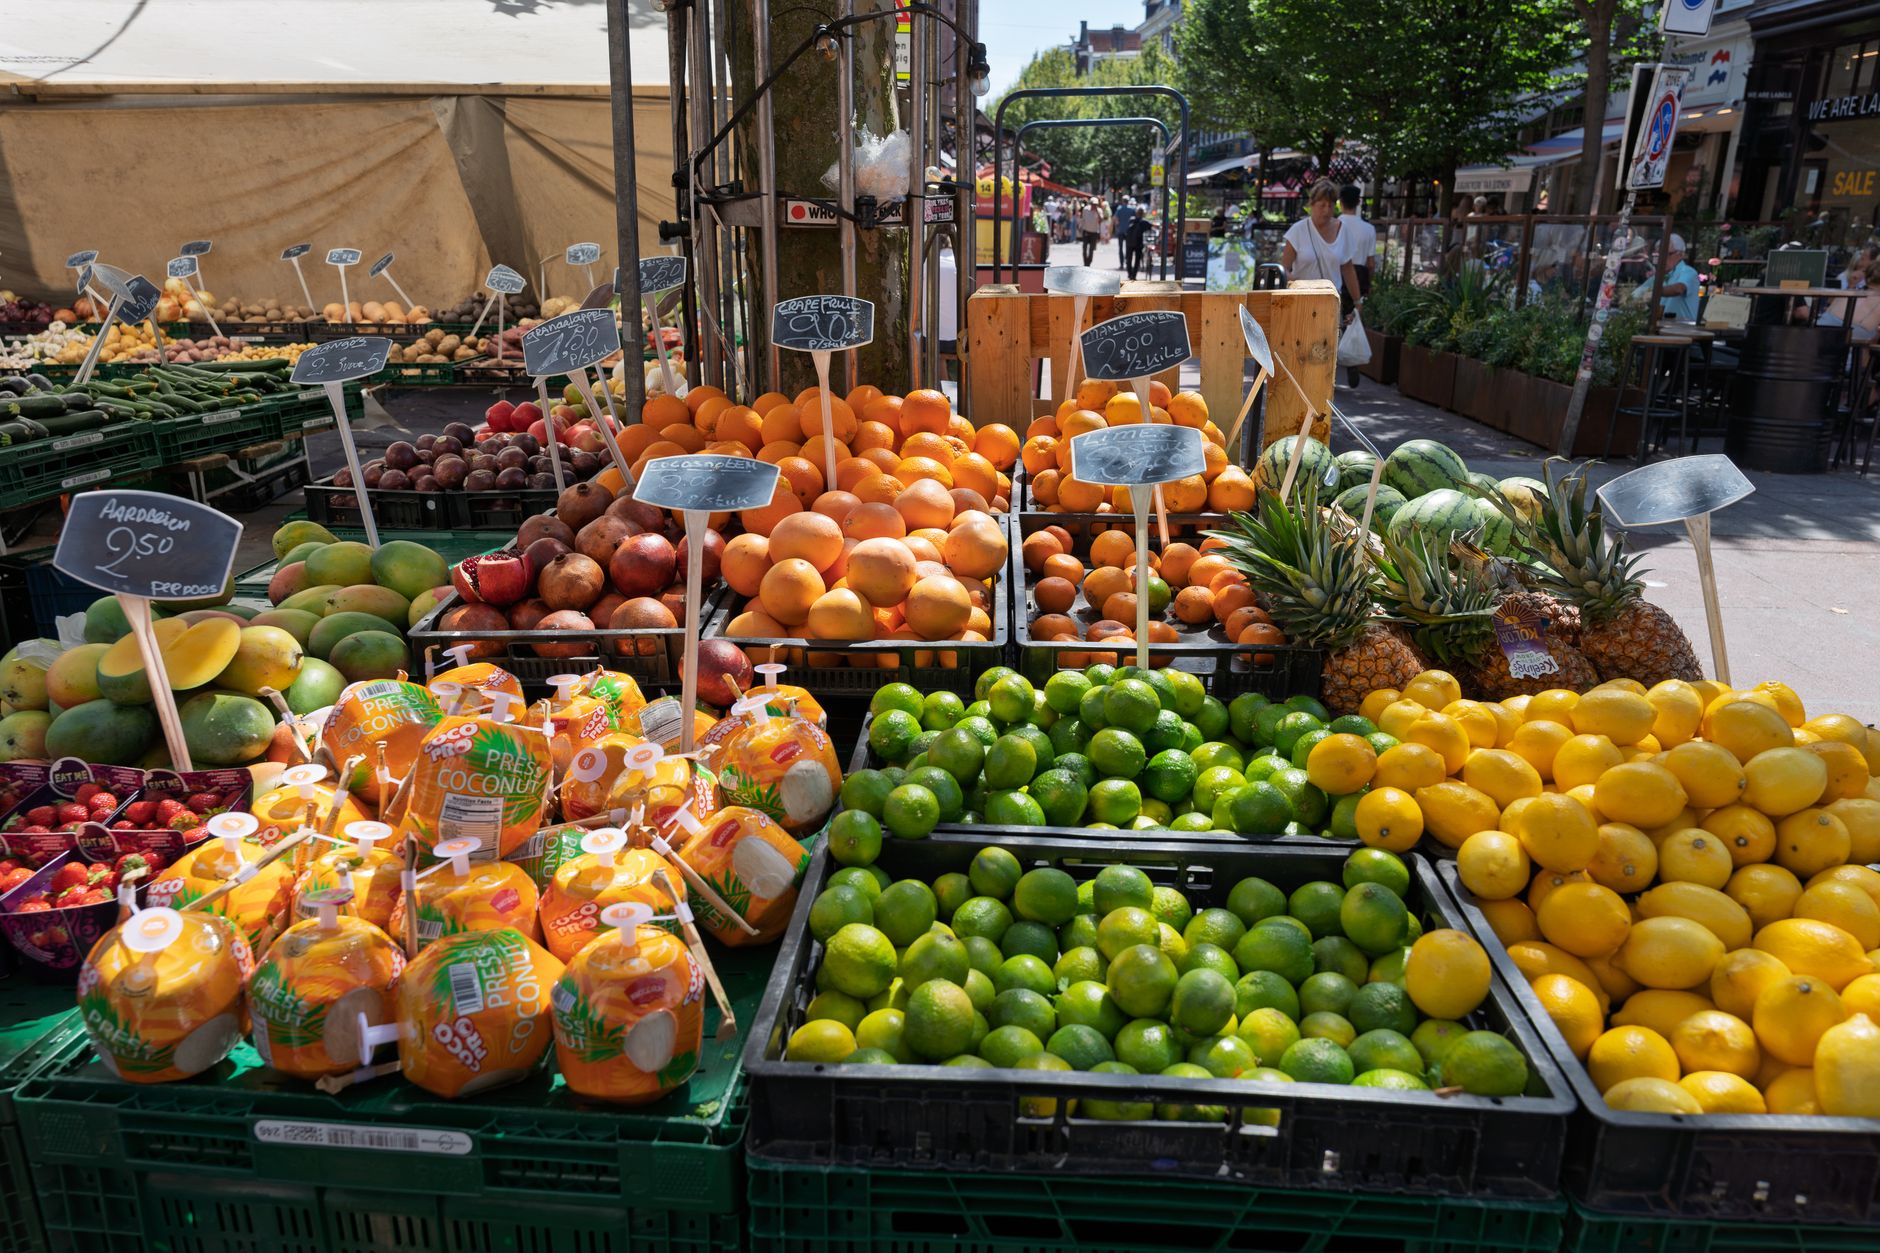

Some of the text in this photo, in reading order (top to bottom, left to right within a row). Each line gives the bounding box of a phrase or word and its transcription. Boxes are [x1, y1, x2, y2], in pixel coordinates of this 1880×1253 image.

[1808, 92, 1880, 120] WE ARE LA
[980, 183, 992, 192] 14
[1833, 170, 1877, 196] SALE
[782, 313, 847, 343] 90
[1512, 658, 1556, 675] Keelings
[362, 694, 420, 717] PRESS
[339, 706, 426, 749] COCONUT
[424, 722, 479, 755] COCO
[430, 738, 474, 763] PRO
[484, 748, 544, 779] PRESS
[54, 772, 73, 784] EAT
[74, 769, 89, 782] ME
[436, 768, 540, 795] COCONUT
[80, 838, 97, 848] EAT
[550, 902, 599, 930] COCO
[556, 916, 598, 937] PRO
[474, 943, 511, 1009] PRESS
[509, 943, 541, 1054] COCONUT
[433, 1022, 481, 1073] COCO
[455, 1017, 487, 1061] PRO
